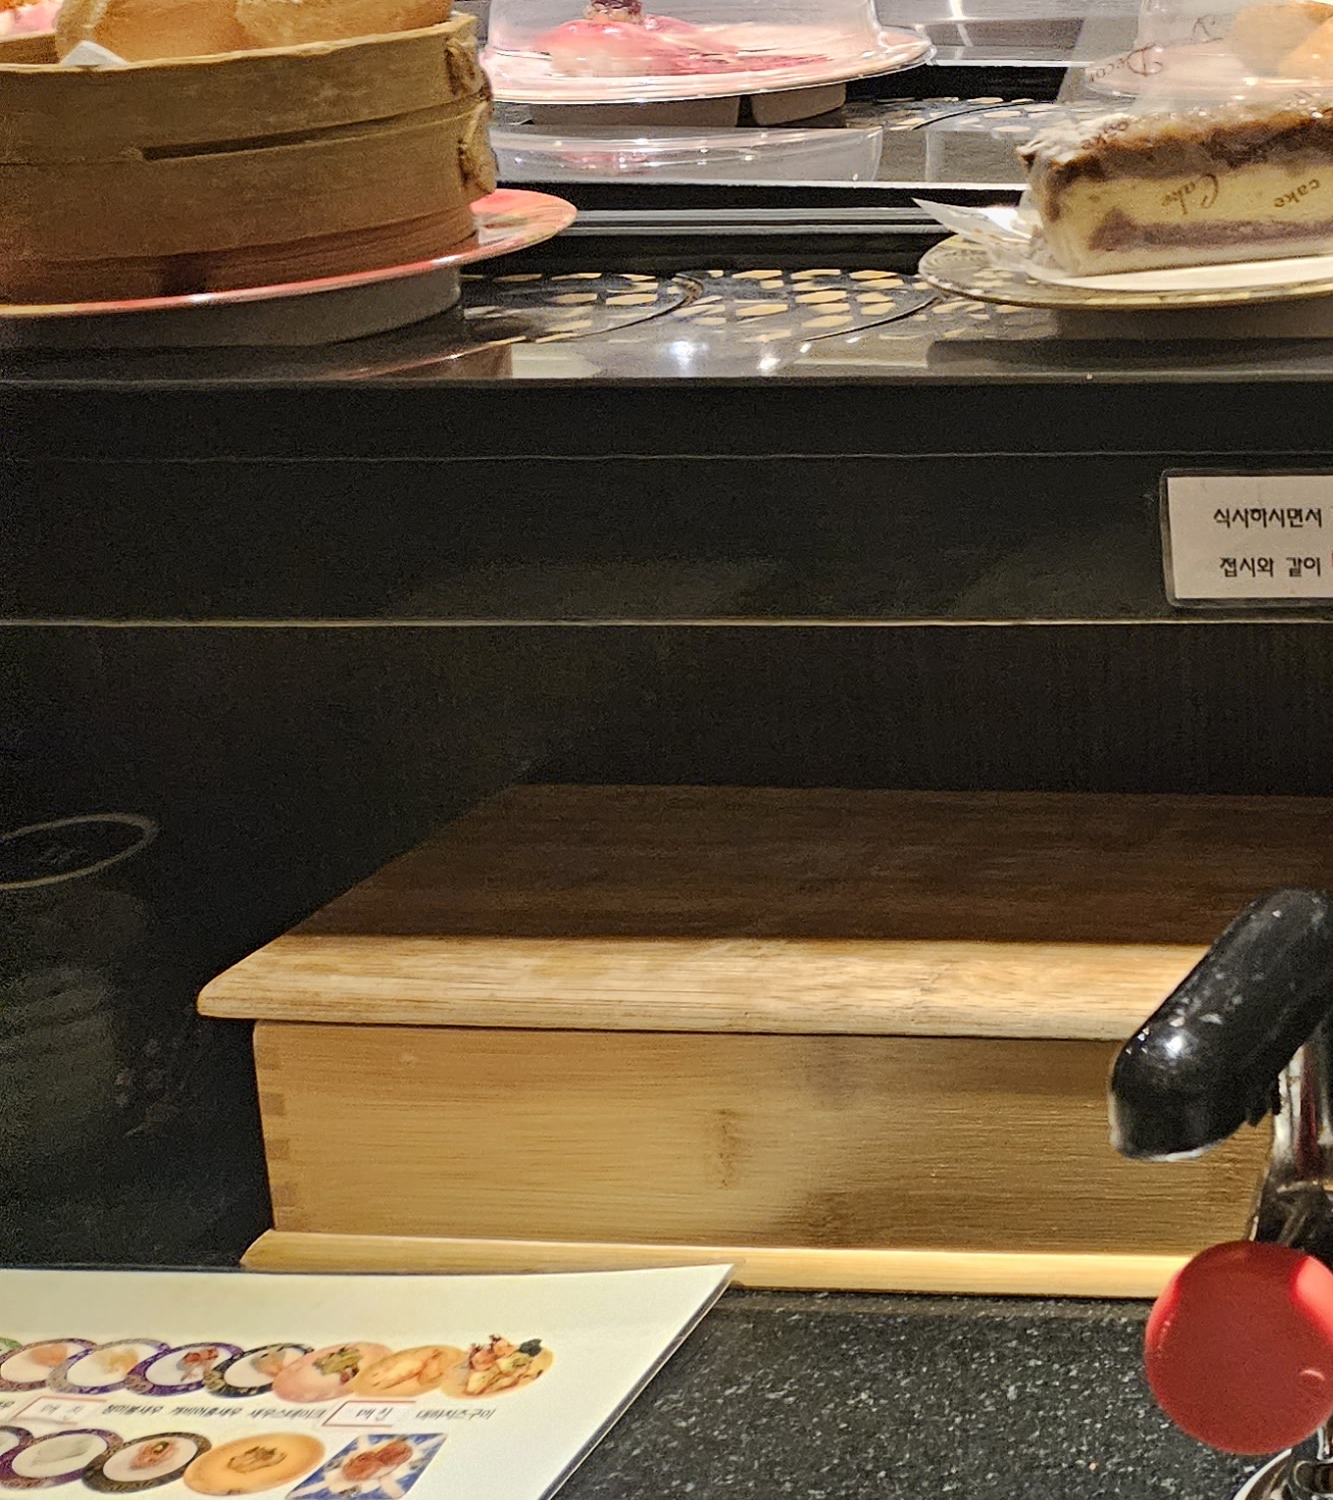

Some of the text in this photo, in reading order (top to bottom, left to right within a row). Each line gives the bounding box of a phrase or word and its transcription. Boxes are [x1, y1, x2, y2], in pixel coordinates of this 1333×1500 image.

[1273, 177, 1322, 208] cake
[1213, 507, 1322, 528] 식사하시면서
[1219, 556, 1274, 578] 접시와
[1286, 556, 1321, 577] 같이
